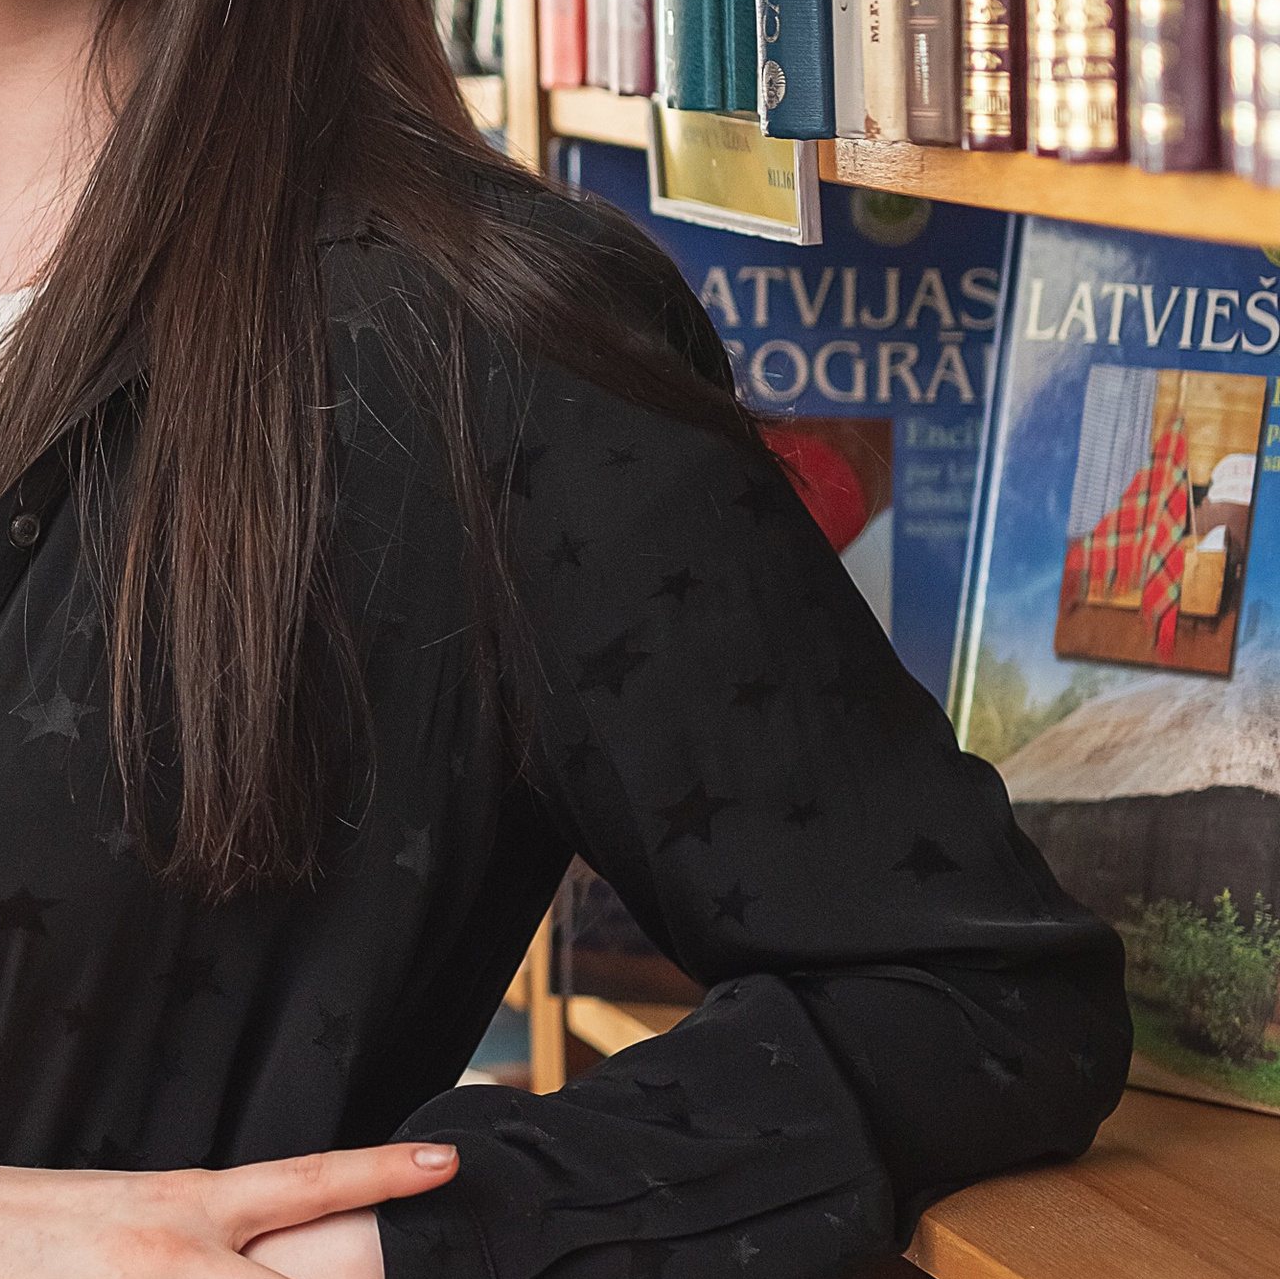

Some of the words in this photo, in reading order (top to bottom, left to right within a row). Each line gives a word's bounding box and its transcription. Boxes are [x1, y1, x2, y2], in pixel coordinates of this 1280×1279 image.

[868, 19, 881, 44] М.
[700, 265, 1002, 332] ATVIJAS
[1024, 274, 1280, 358] LATVIEŠ
